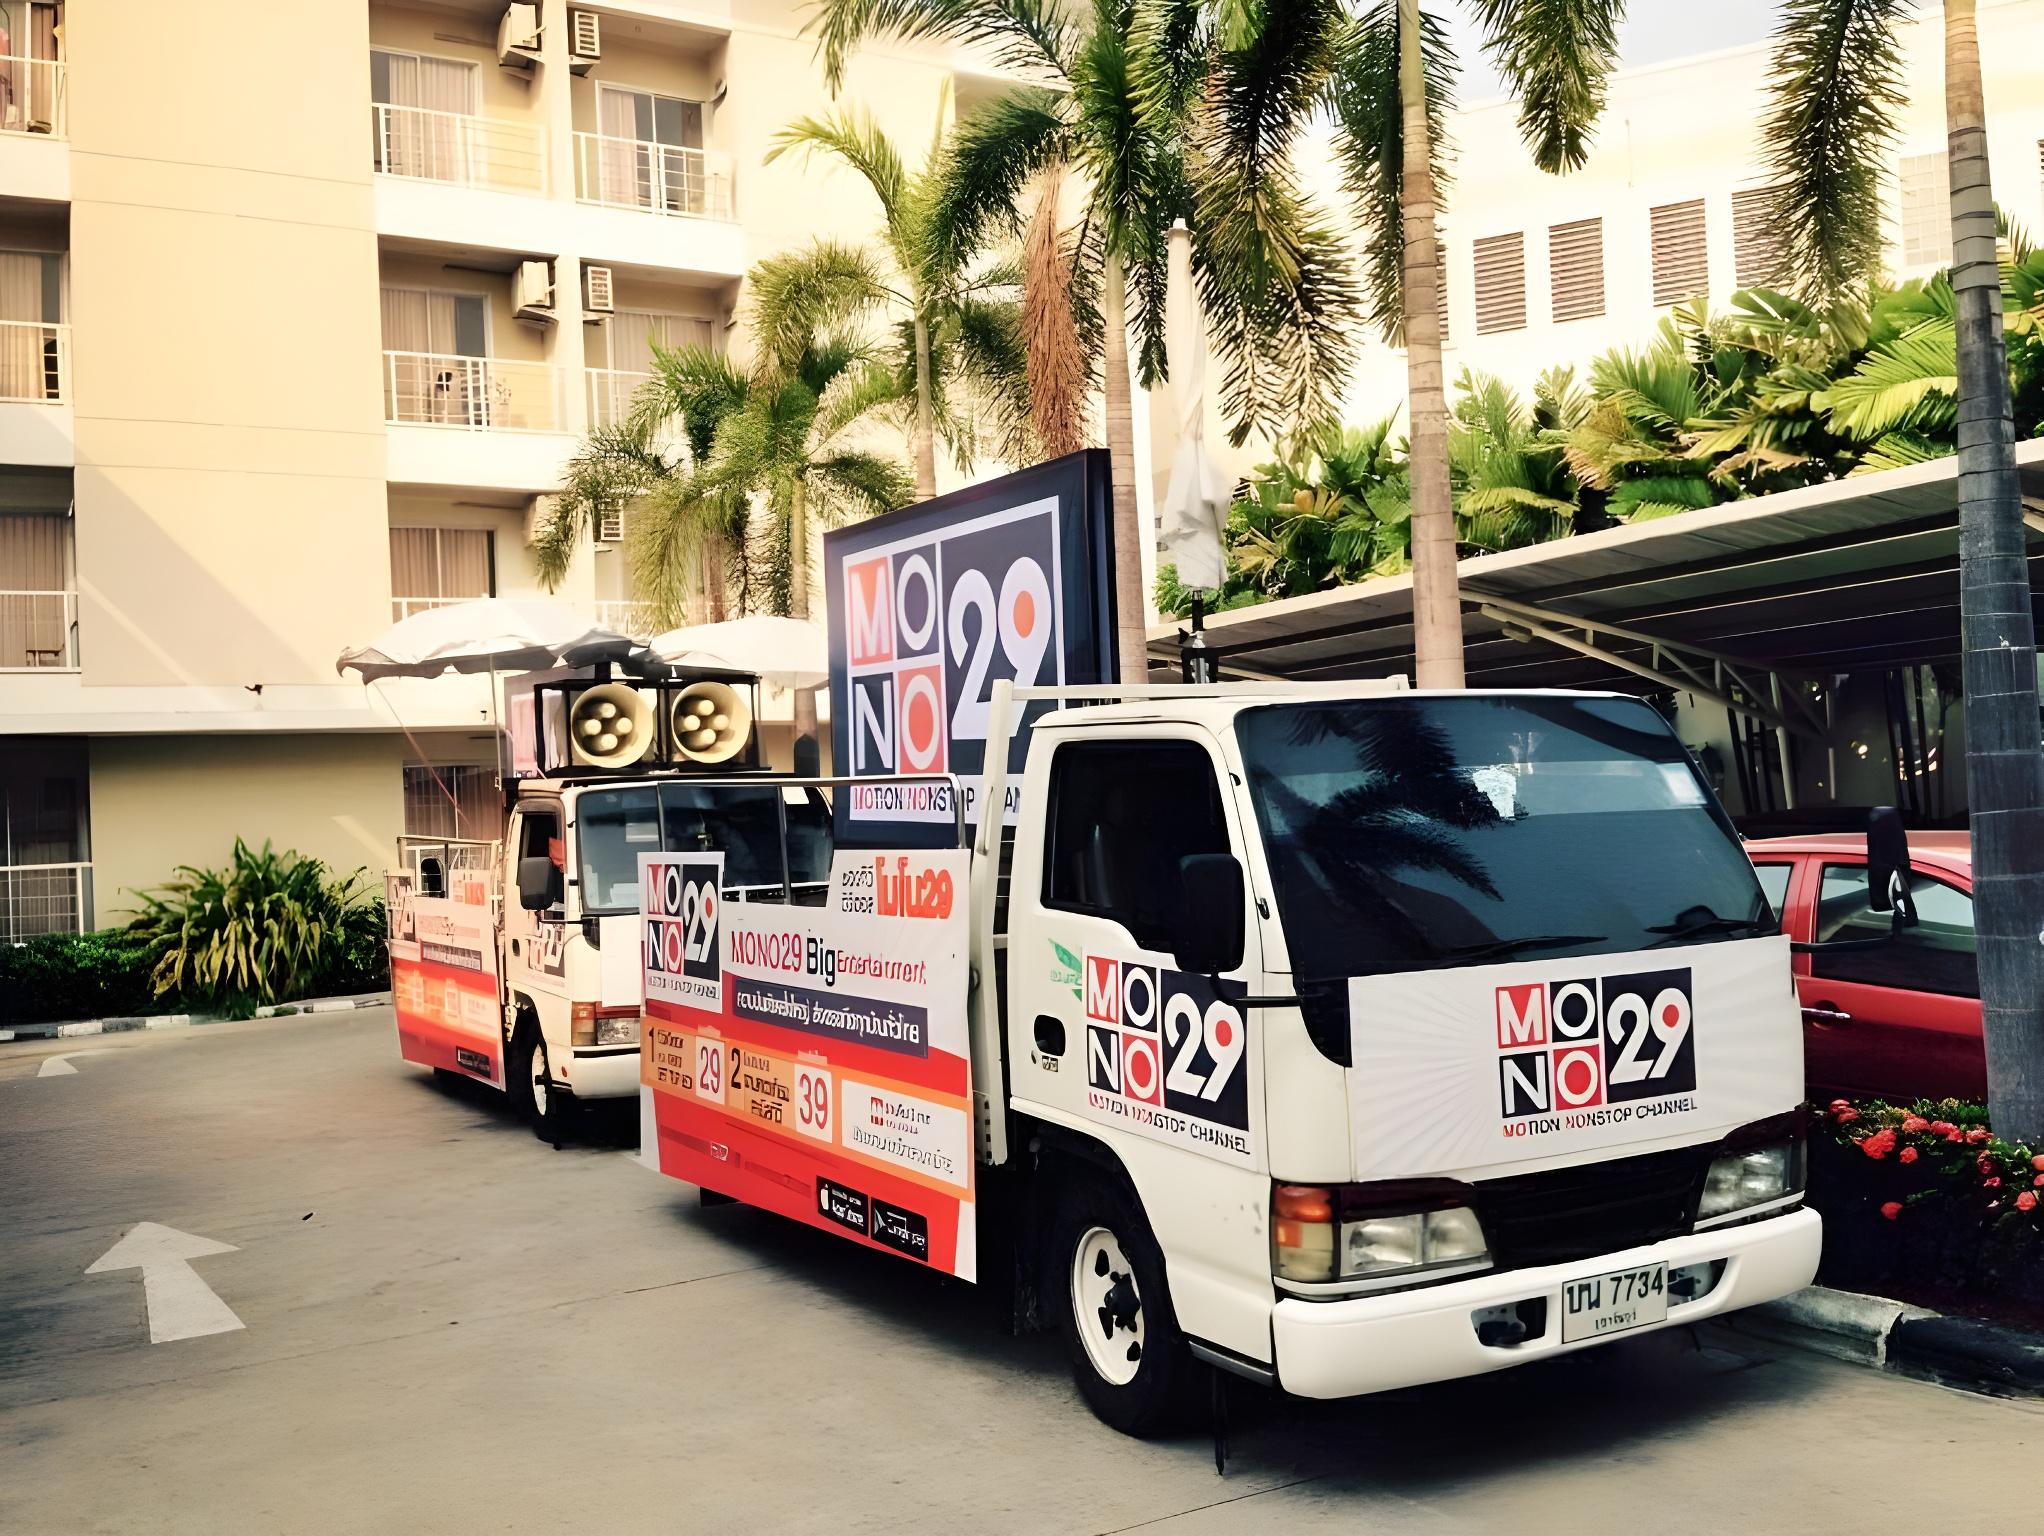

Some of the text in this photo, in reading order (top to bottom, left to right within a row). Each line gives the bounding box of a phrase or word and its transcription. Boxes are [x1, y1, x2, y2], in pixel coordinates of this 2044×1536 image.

[948, 556, 1052, 740] 29
[683, 880, 718, 963] 29
[731, 931, 802, 972] MONO29
[806, 937, 836, 987] Big
[1164, 992, 1245, 1102] 29
[1606, 987, 1692, 1085] 29
[700, 1046, 721, 1094] 29
[731, 1047, 742, 1090] 2
[799, 1073, 828, 1130] 39
[1610, 1267, 1664, 1305] 7734
